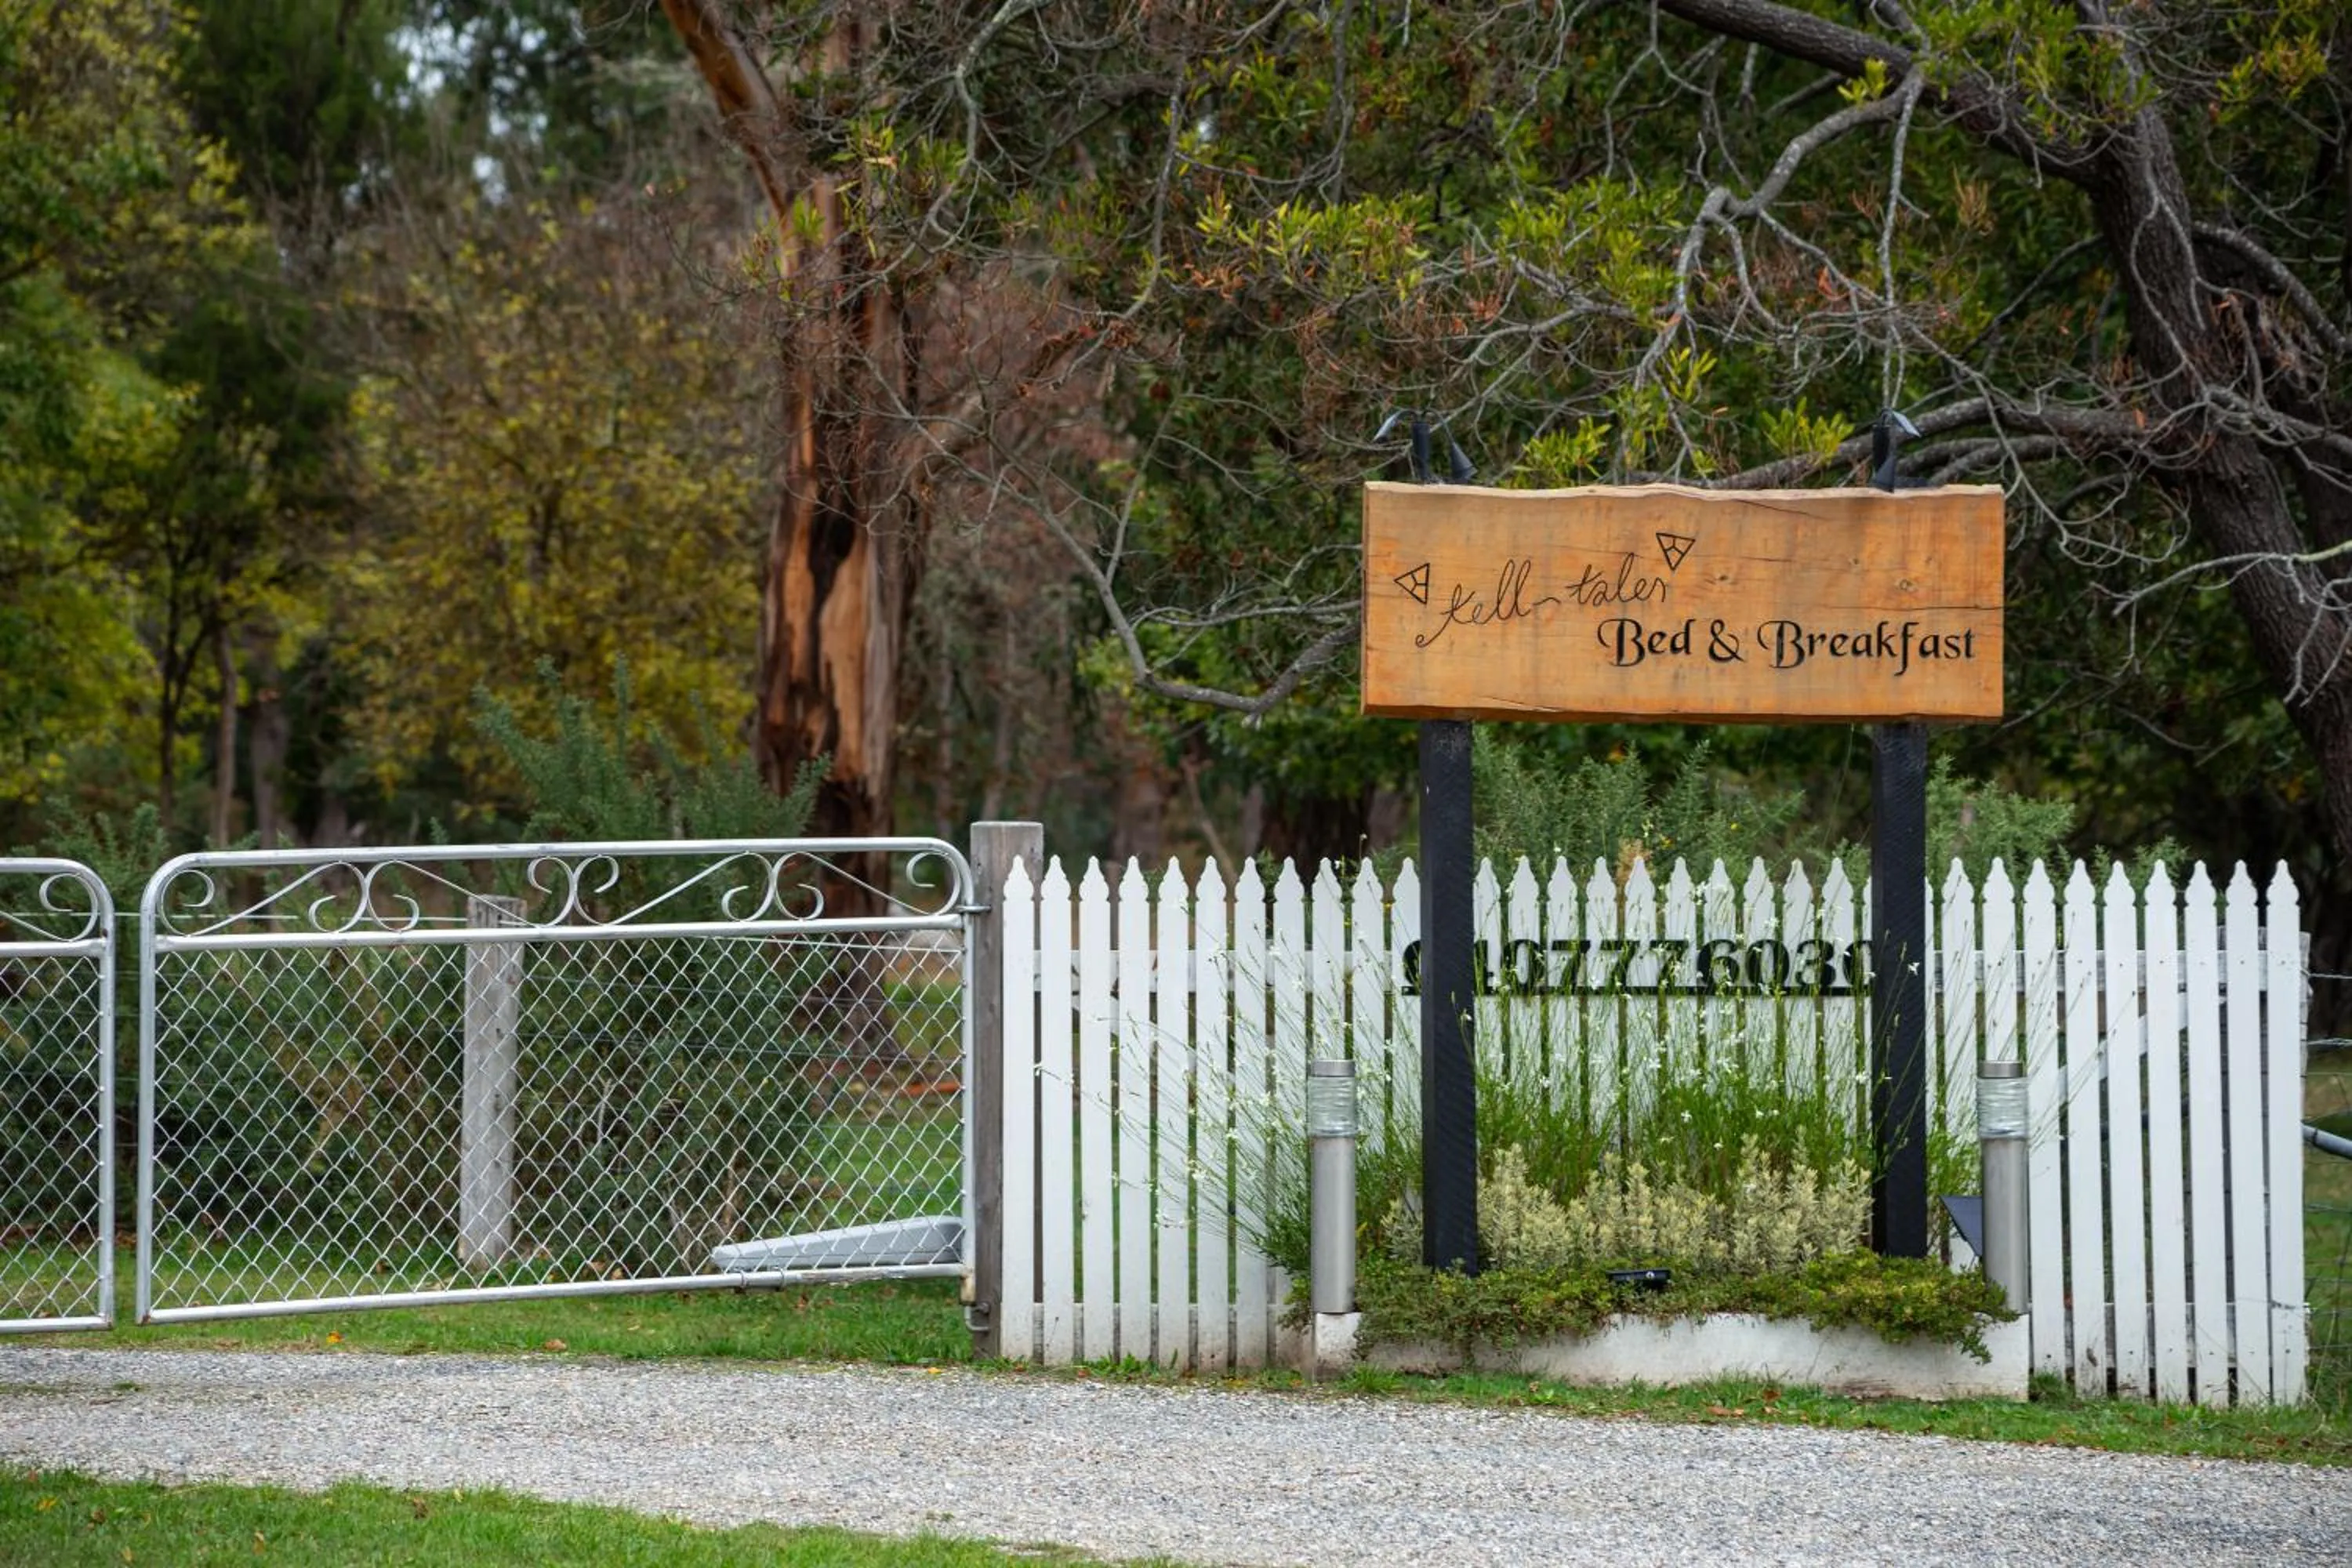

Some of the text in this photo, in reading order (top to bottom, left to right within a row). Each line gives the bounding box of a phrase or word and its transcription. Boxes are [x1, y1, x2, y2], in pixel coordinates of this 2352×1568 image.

[1597, 618, 1974, 677] Bed & Breakfast
